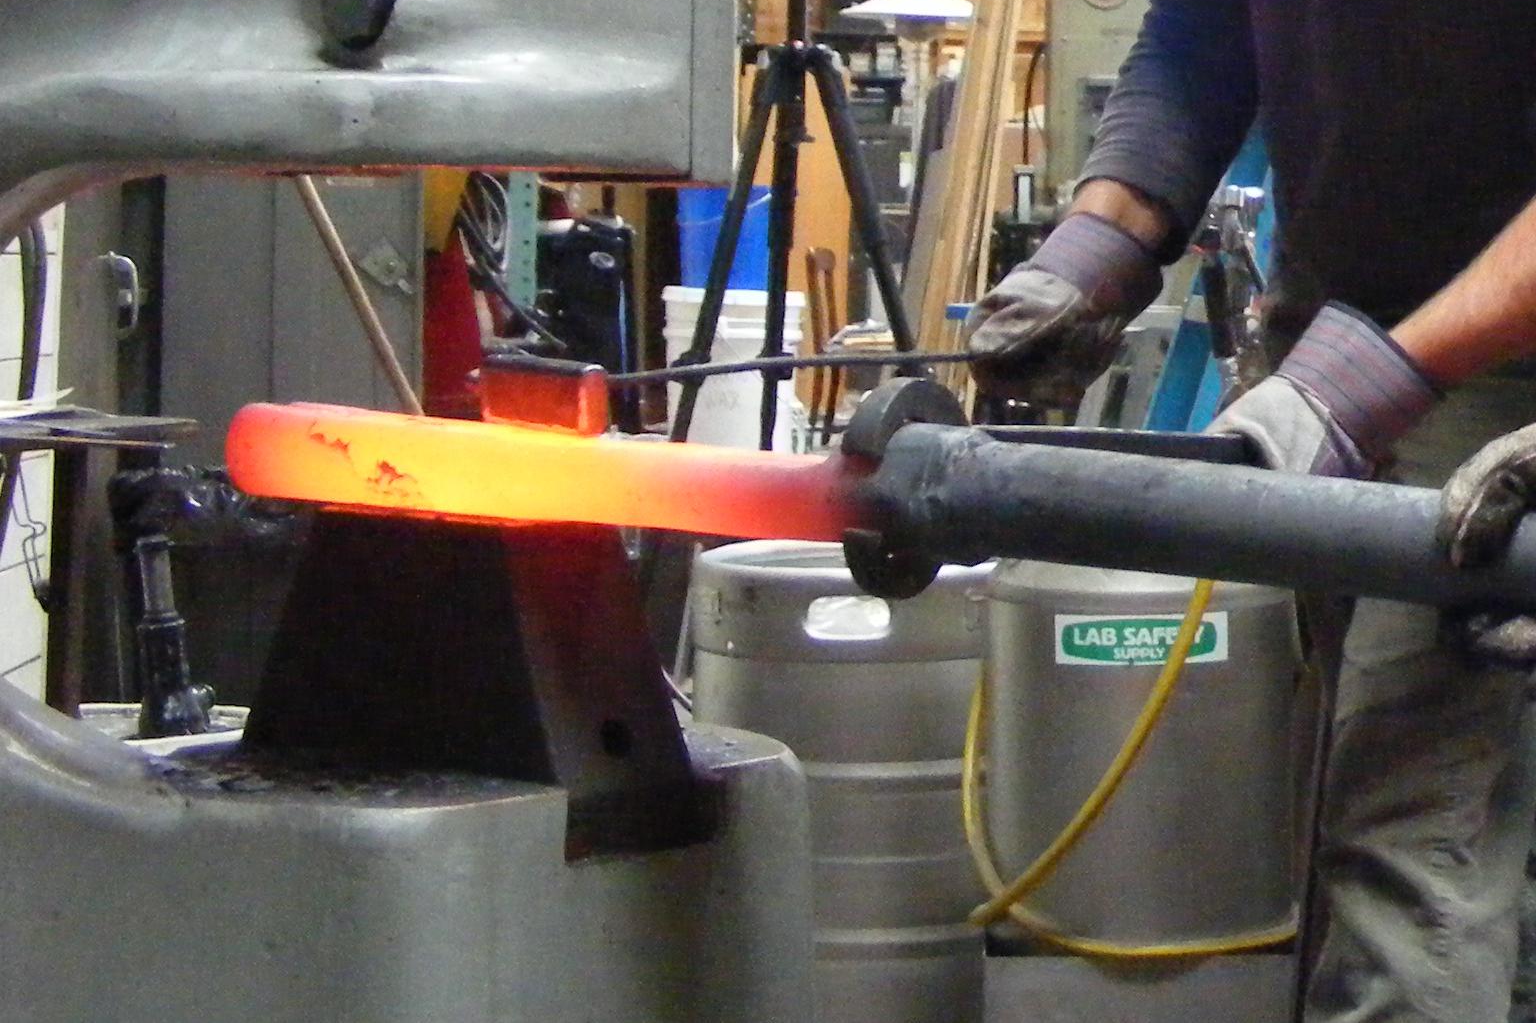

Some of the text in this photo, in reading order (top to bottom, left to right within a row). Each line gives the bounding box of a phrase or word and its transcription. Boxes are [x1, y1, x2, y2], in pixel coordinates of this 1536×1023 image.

[1073, 625, 1205, 646] LAB SAFEY
[1113, 647, 1165, 660] SUPPLY
